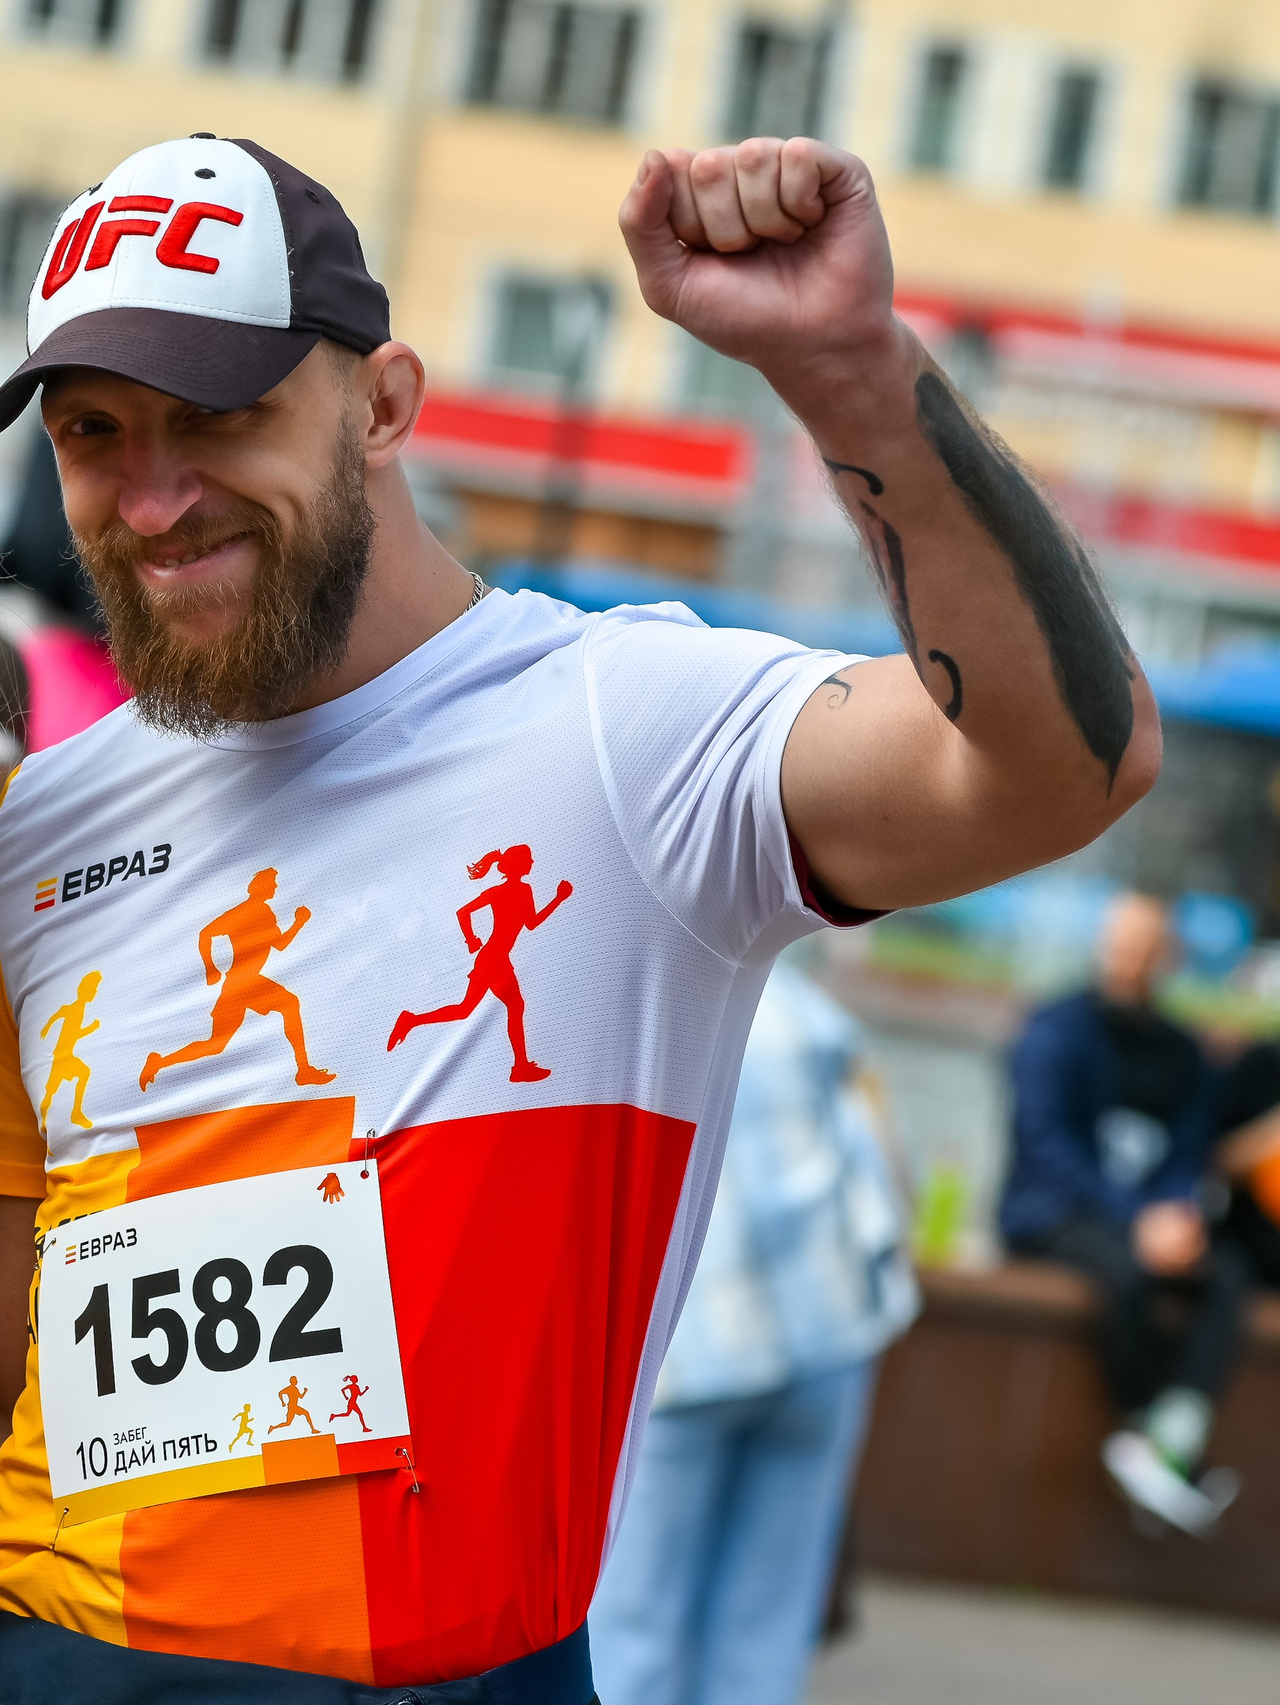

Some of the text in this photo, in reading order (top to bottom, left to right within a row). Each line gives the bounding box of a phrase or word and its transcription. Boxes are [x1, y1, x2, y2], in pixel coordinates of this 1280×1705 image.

[41, 194, 244, 300] UFC
[61, 843, 173, 903] ЕВРАЗ
[79, 1227, 138, 1260] ЕВРАЗ
[74, 1243, 343, 1398] 1582
[76, 1436, 108, 1480] 10
[113, 1426, 148, 1446] ЗАБЕГ
[114, 1432, 218, 1476] ДАЙ ПЯТЬ
